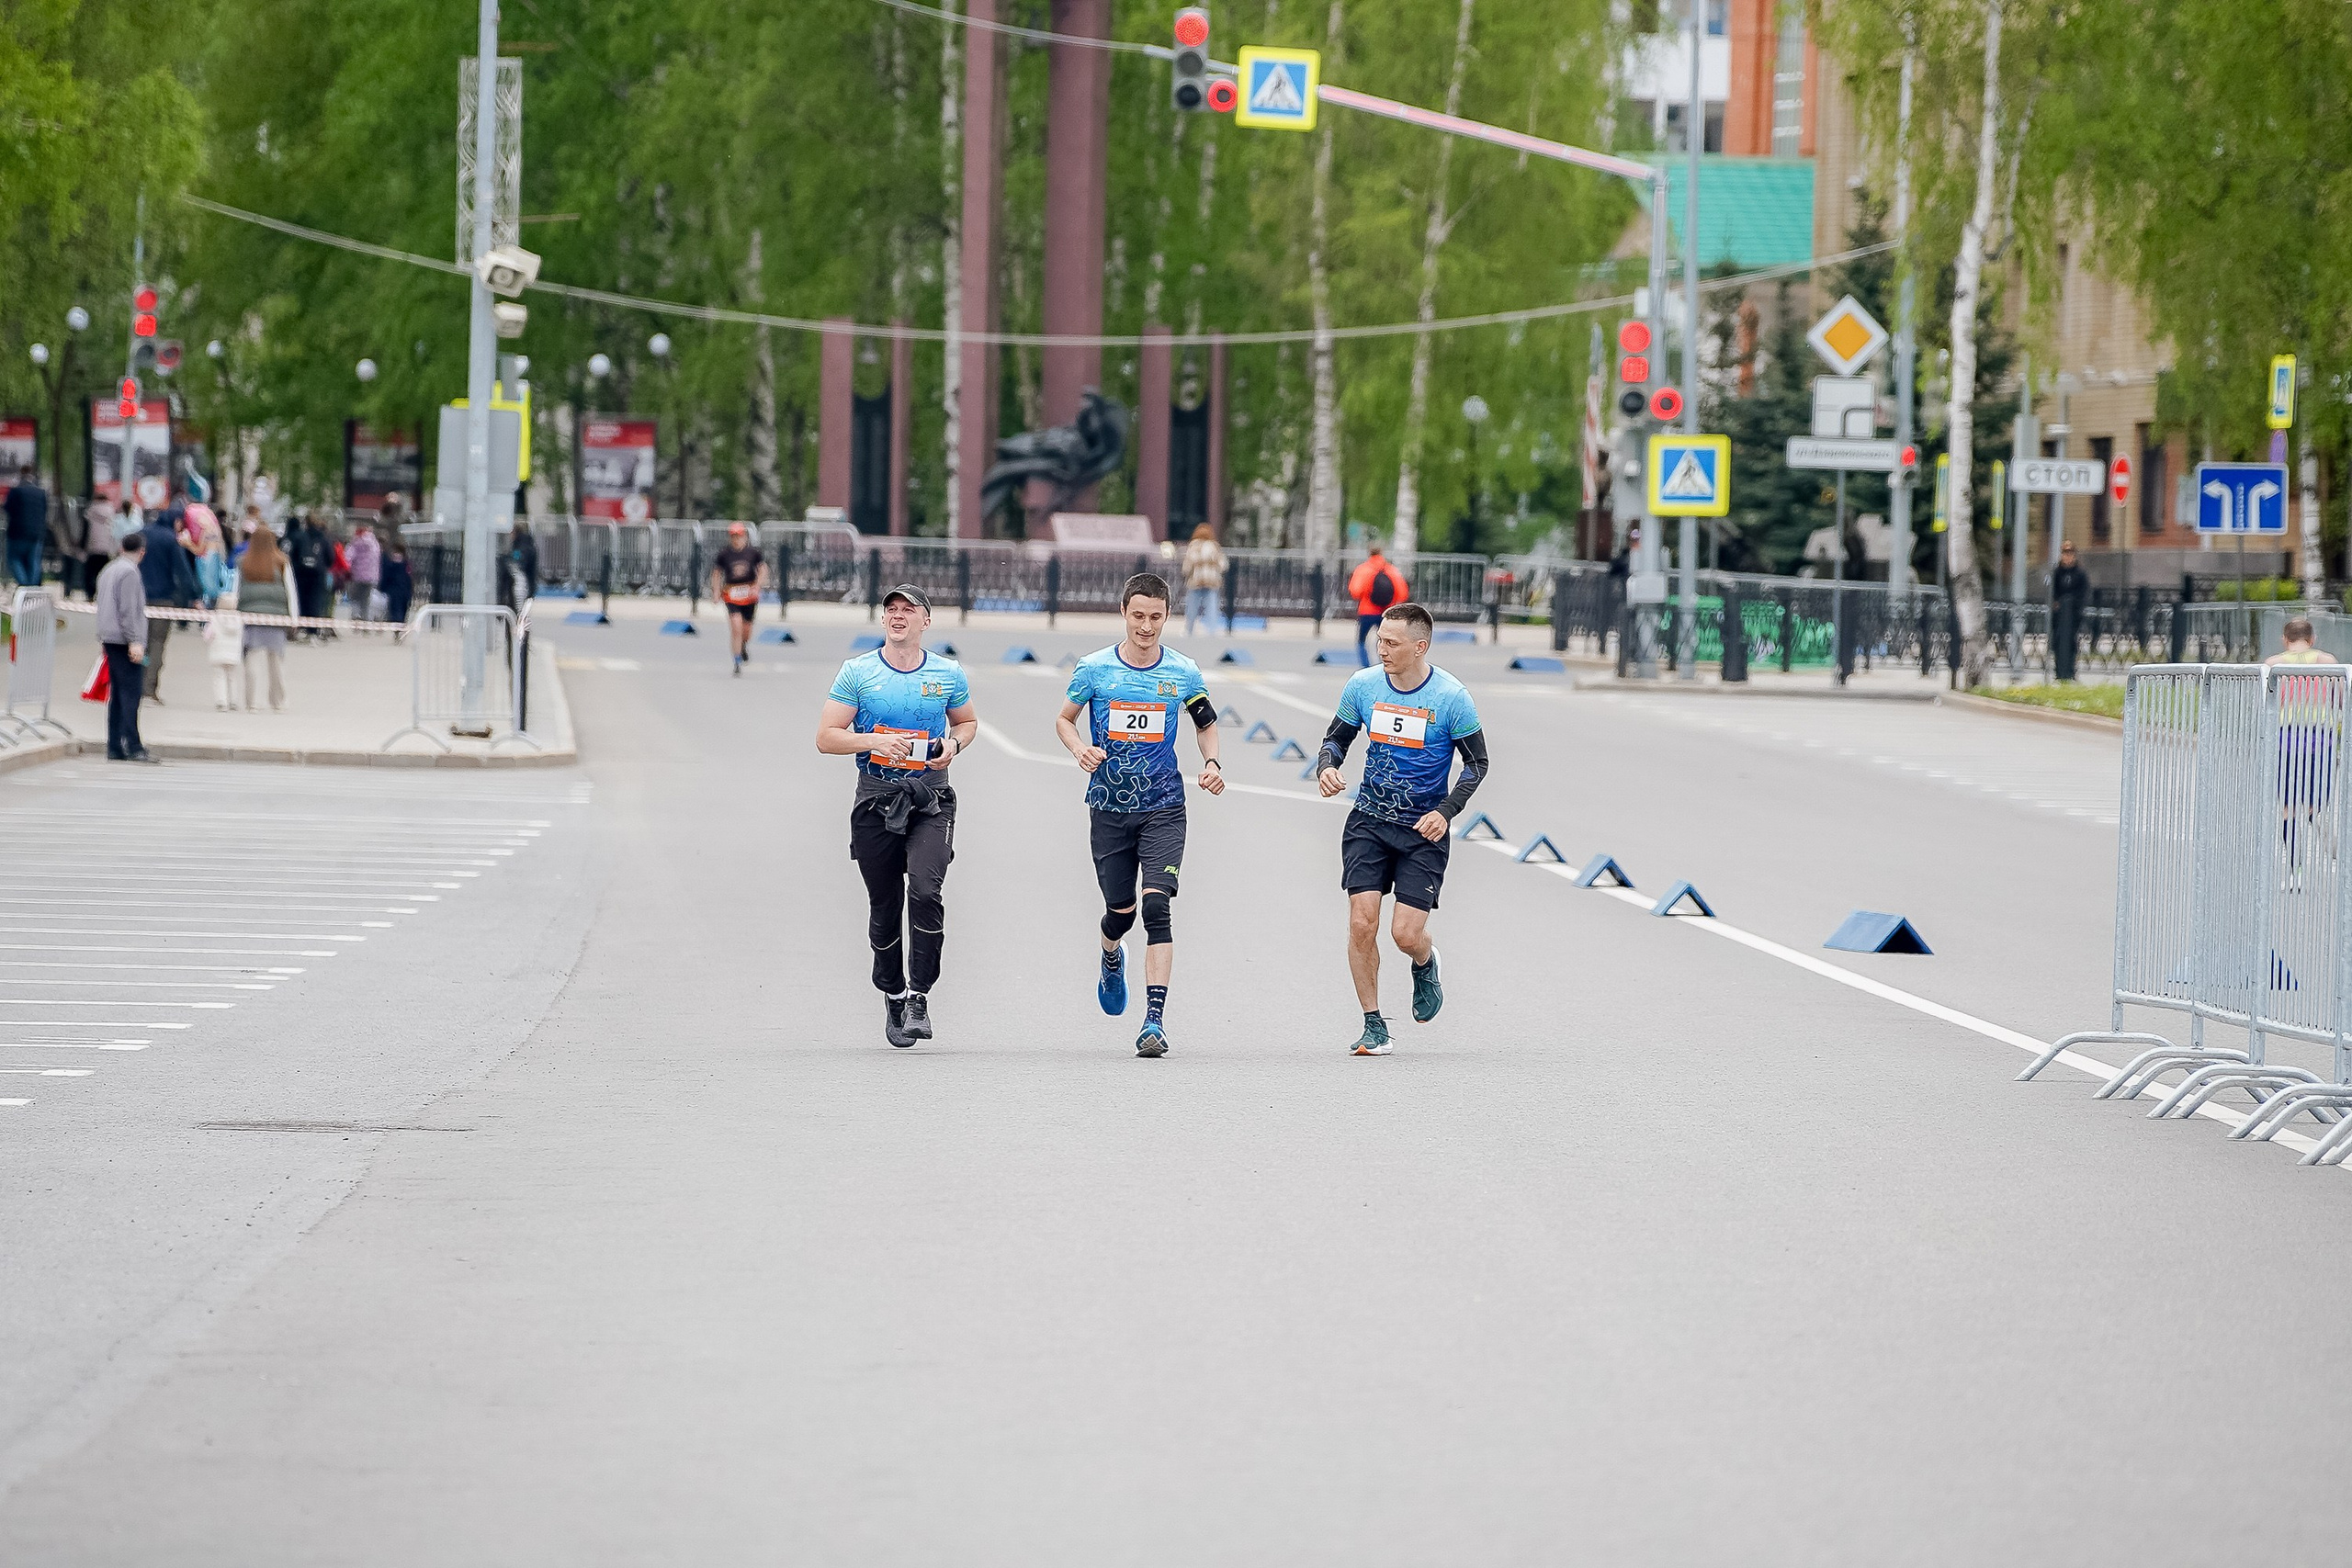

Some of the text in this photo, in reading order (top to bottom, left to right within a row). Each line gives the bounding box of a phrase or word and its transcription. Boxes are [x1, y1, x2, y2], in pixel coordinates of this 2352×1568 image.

[2025, 463, 2091, 487] СТОП
[1126, 714, 1148, 729] 20
[1393, 716, 1404, 733] 5
